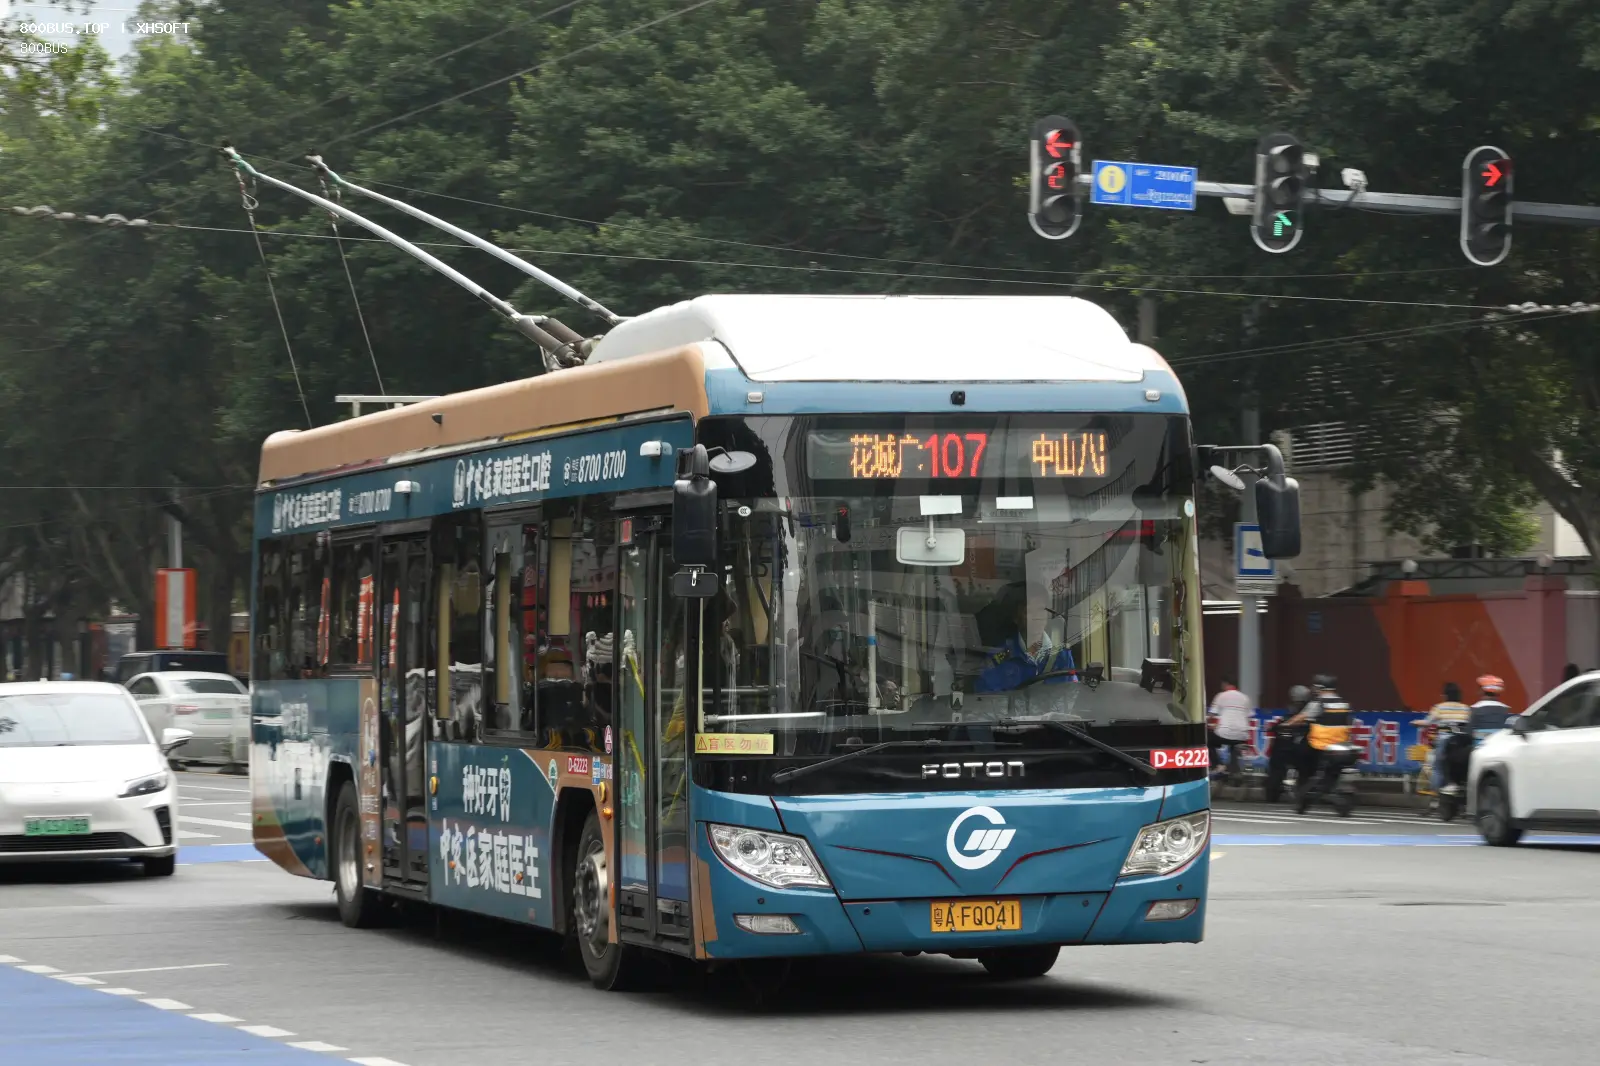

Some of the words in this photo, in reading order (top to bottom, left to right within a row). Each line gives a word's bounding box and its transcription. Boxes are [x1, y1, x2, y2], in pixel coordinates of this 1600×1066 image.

[578, 453, 602, 484] 8700
[602, 449, 627, 481] 8700
[850, 433, 923, 478] 花城广
[923, 433, 987, 478] 107
[1031, 433, 1105, 477] 中山八
[921, 760, 1025, 779] FOTON
